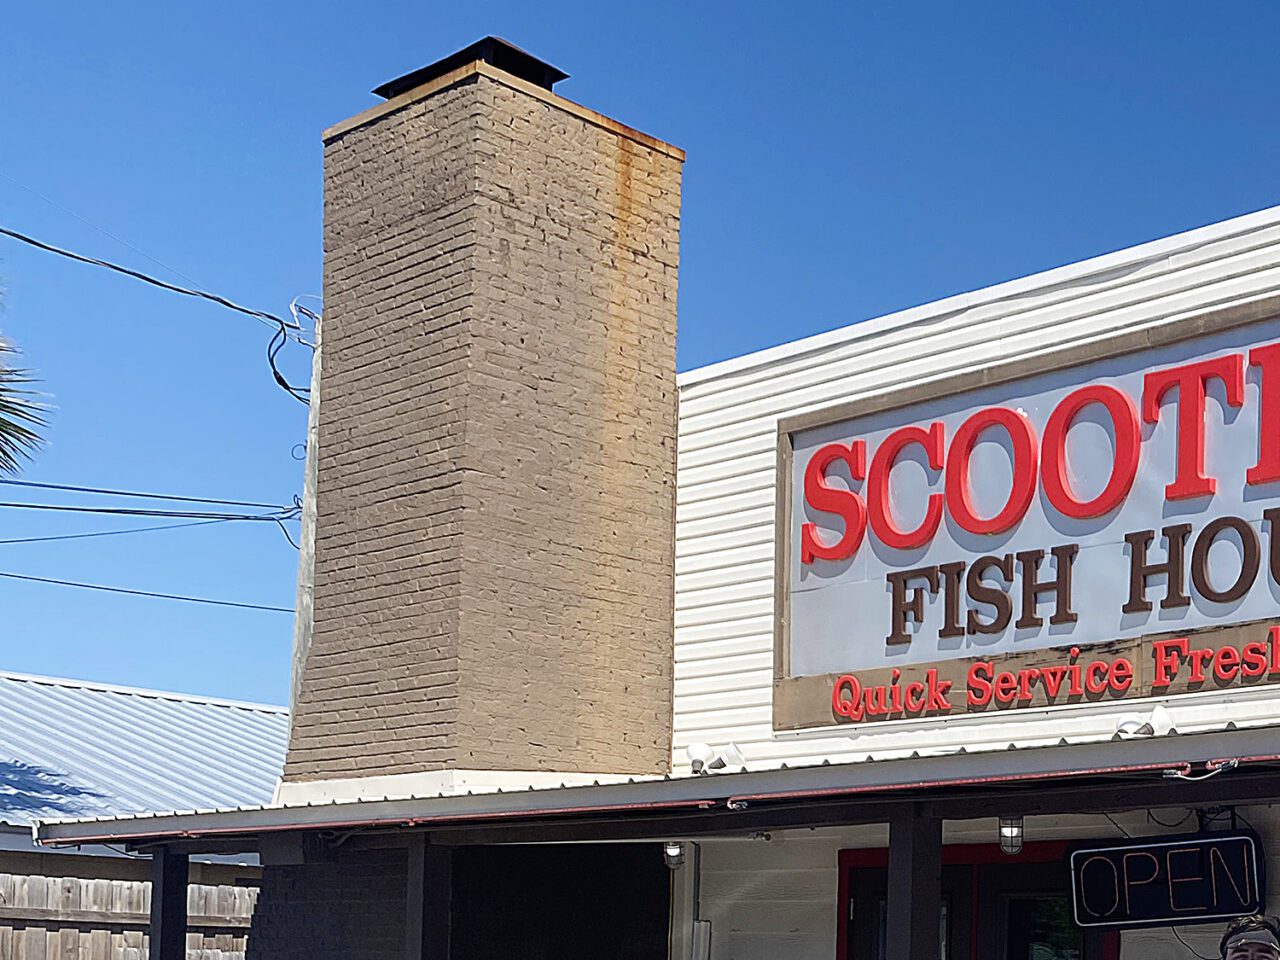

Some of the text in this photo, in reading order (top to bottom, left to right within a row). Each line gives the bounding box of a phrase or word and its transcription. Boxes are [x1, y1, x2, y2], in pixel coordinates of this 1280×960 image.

[885, 543, 1080, 646] FISH
[831, 667, 952, 723] Quick
[966, 647, 1134, 709] Service
[1080, 844, 1250, 917] OPEN
